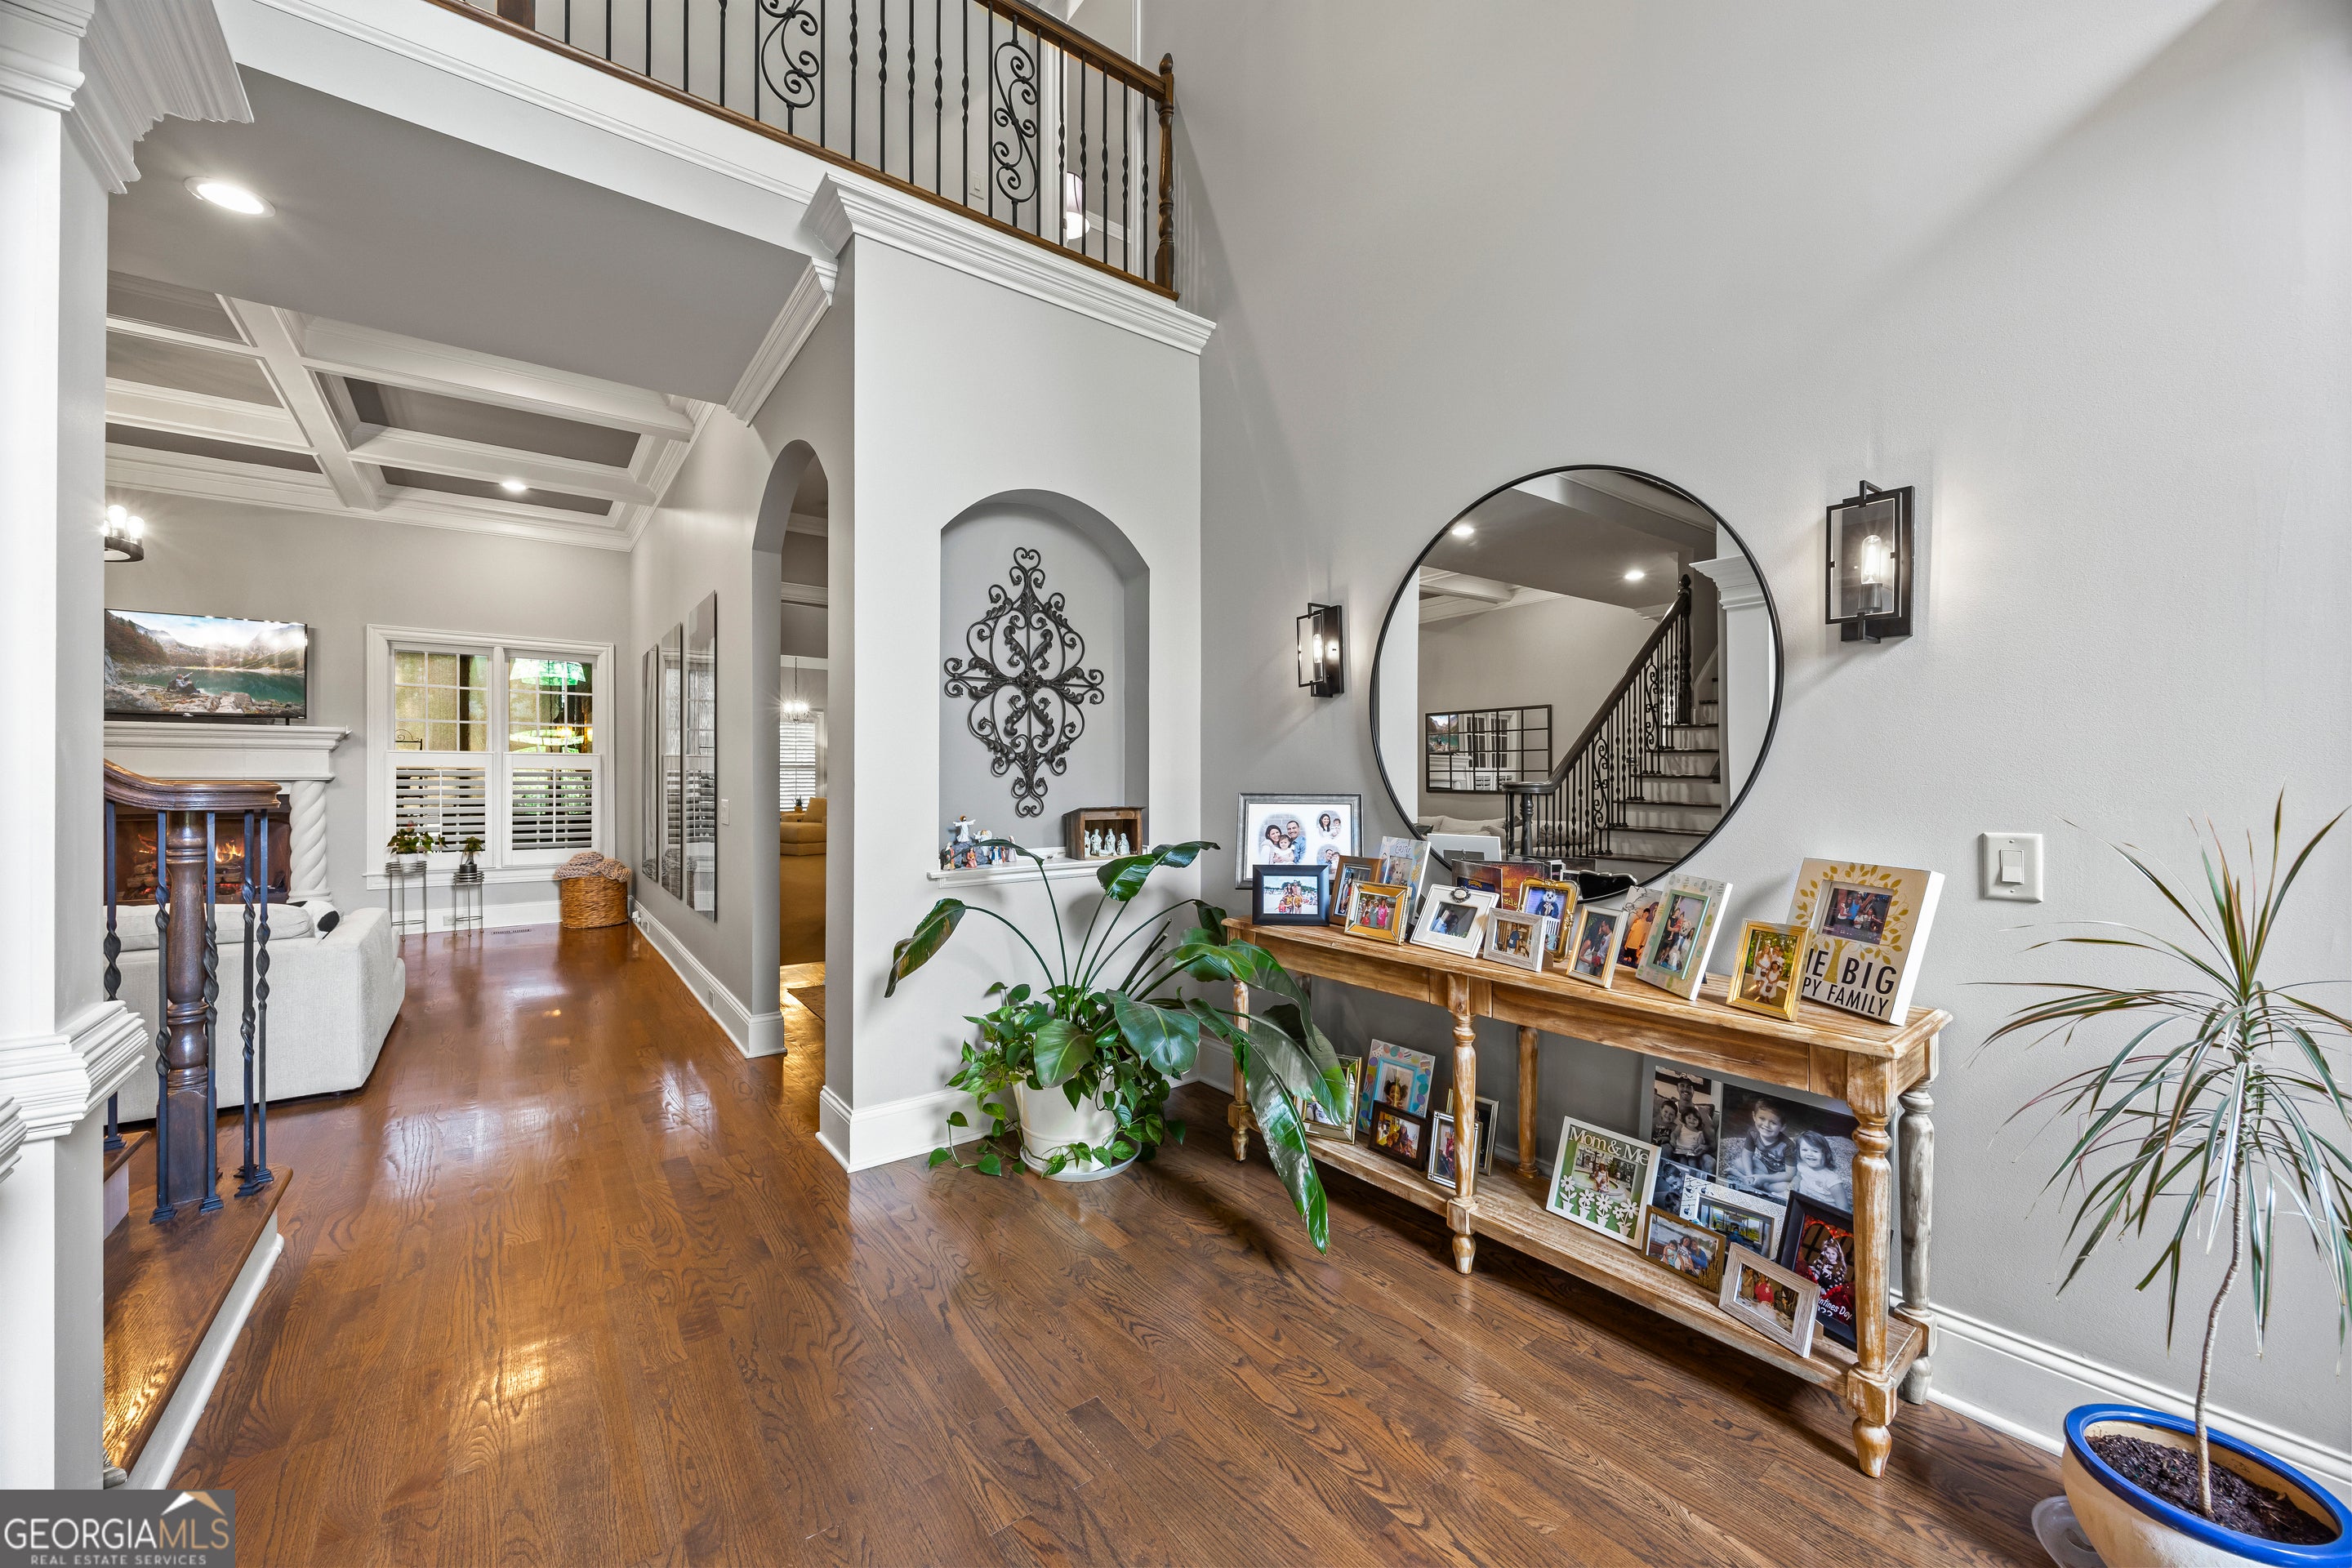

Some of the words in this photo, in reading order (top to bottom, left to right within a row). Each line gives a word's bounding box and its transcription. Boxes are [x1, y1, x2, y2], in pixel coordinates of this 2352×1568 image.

[1841, 956, 1896, 995] BIG
[1826, 983, 1889, 1017] FAMILY
[1569, 1126, 1606, 1152] Mom
[1607, 1139, 1622, 1156] &
[1623, 1143, 1649, 1166] Me
